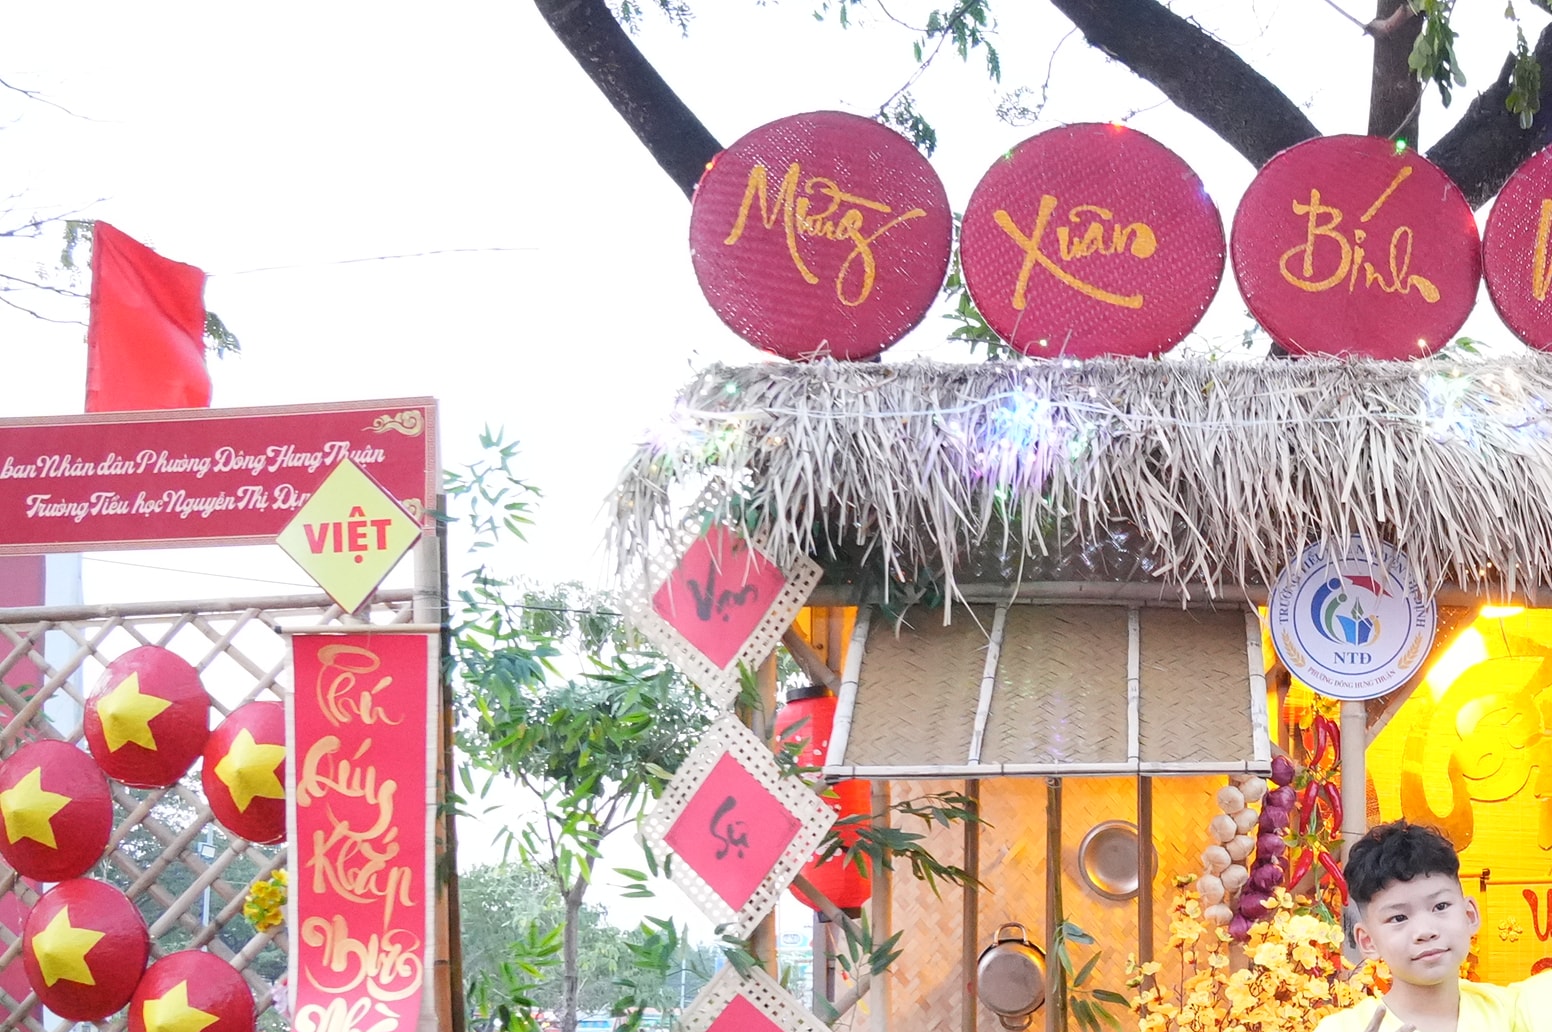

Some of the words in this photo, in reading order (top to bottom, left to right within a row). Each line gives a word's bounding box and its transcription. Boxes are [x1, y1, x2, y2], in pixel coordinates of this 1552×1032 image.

[993, 194, 1157, 310] Xuân
[1278, 165, 1440, 304] Bính
[36, 454, 95, 478] Nhân
[96, 452, 135, 475] dân
[131, 490, 163, 517] học
[236, 485, 269, 512] Thị
[303, 506, 392, 564] VIỆT
[1333, 651, 1372, 665] NTĐ
